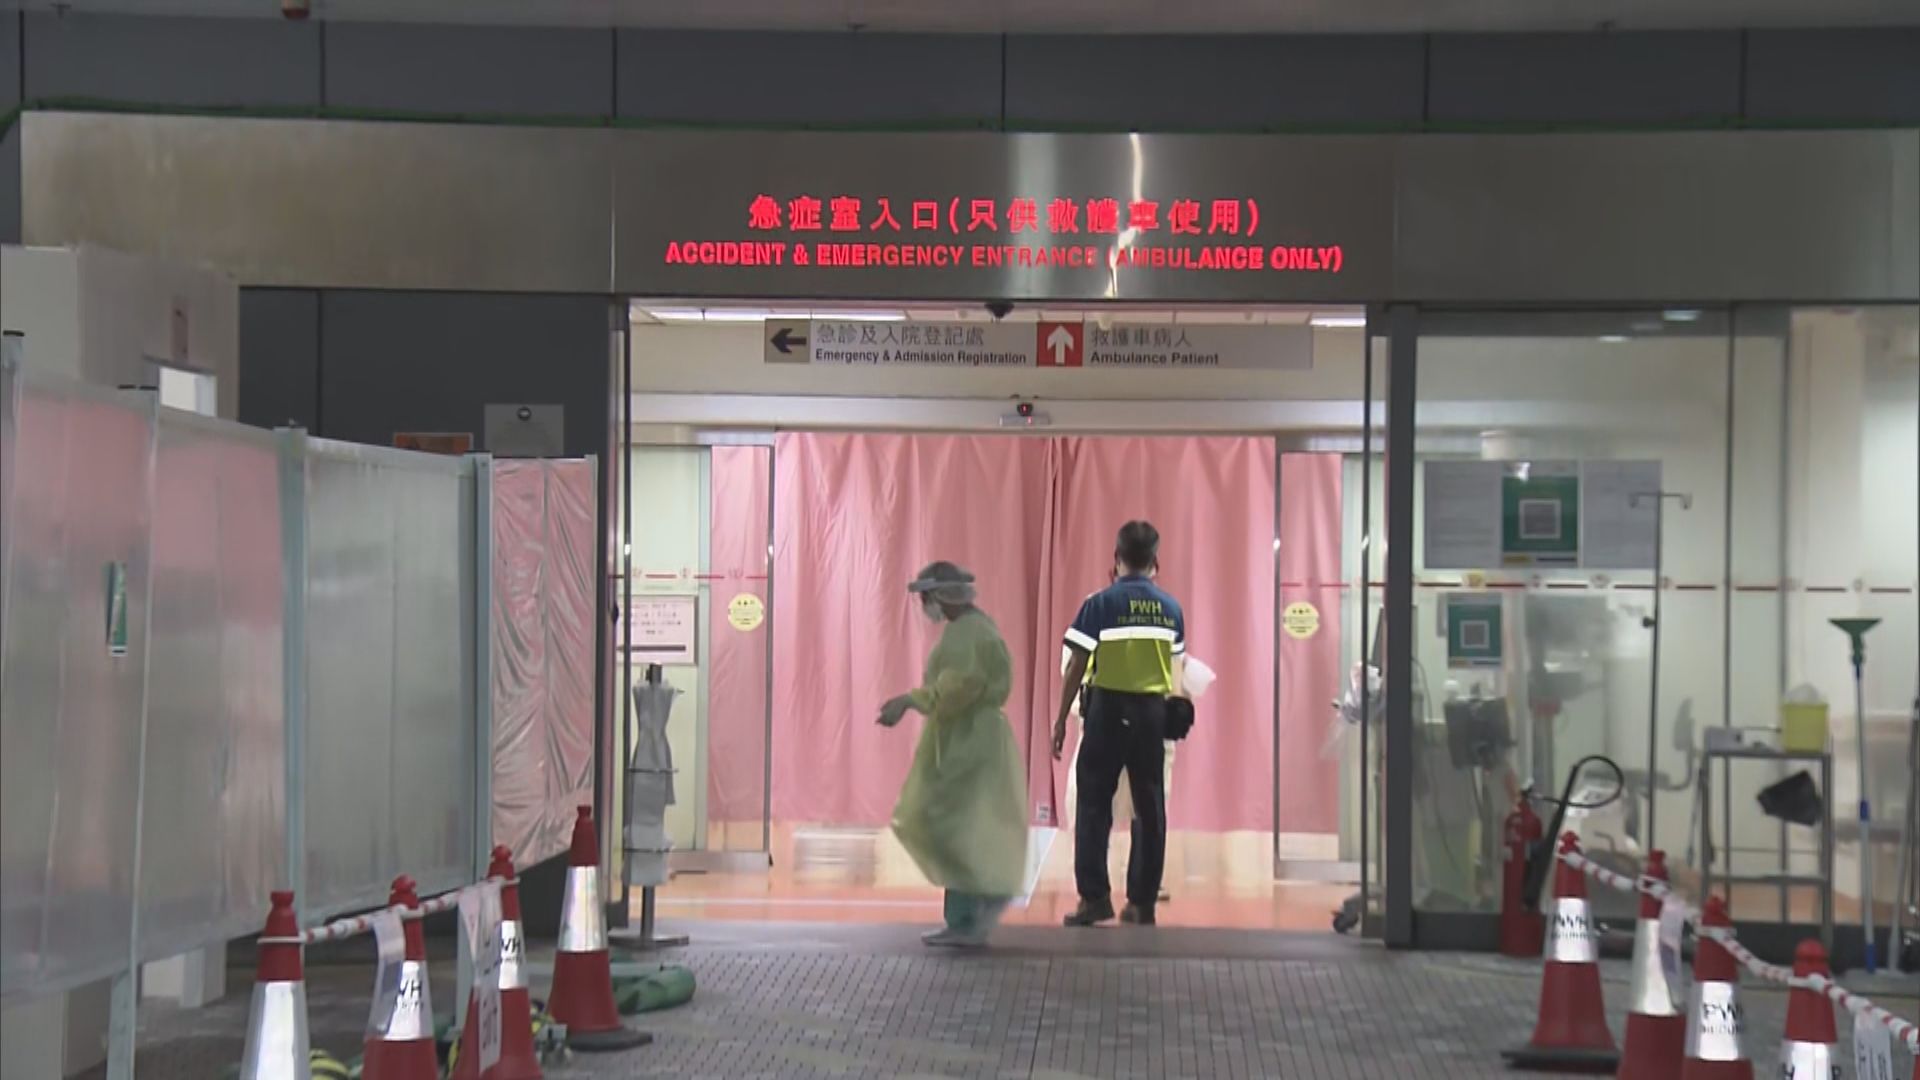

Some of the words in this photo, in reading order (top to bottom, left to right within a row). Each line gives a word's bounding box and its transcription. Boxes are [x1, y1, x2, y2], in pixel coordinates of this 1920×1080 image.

[665, 241, 786, 265] ACCIDENT
[792, 243, 809, 265] &
[816, 243, 964, 267] EMERGENCY
[971, 245, 1097, 268] ENTRANCE
[1107, 246, 1263, 271] (AMBULANCE
[1269, 246, 1343, 273] ONLY)
[815, 349, 878, 364] Emergency
[883, 350, 890, 362] &
[894, 349, 955, 363] Admission
[958, 350, 1027, 365] Registration
[1090, 351, 1167, 365] Ambulance
[1171, 352, 1219, 366] Patient
[1129, 599, 1162, 614] PWH
